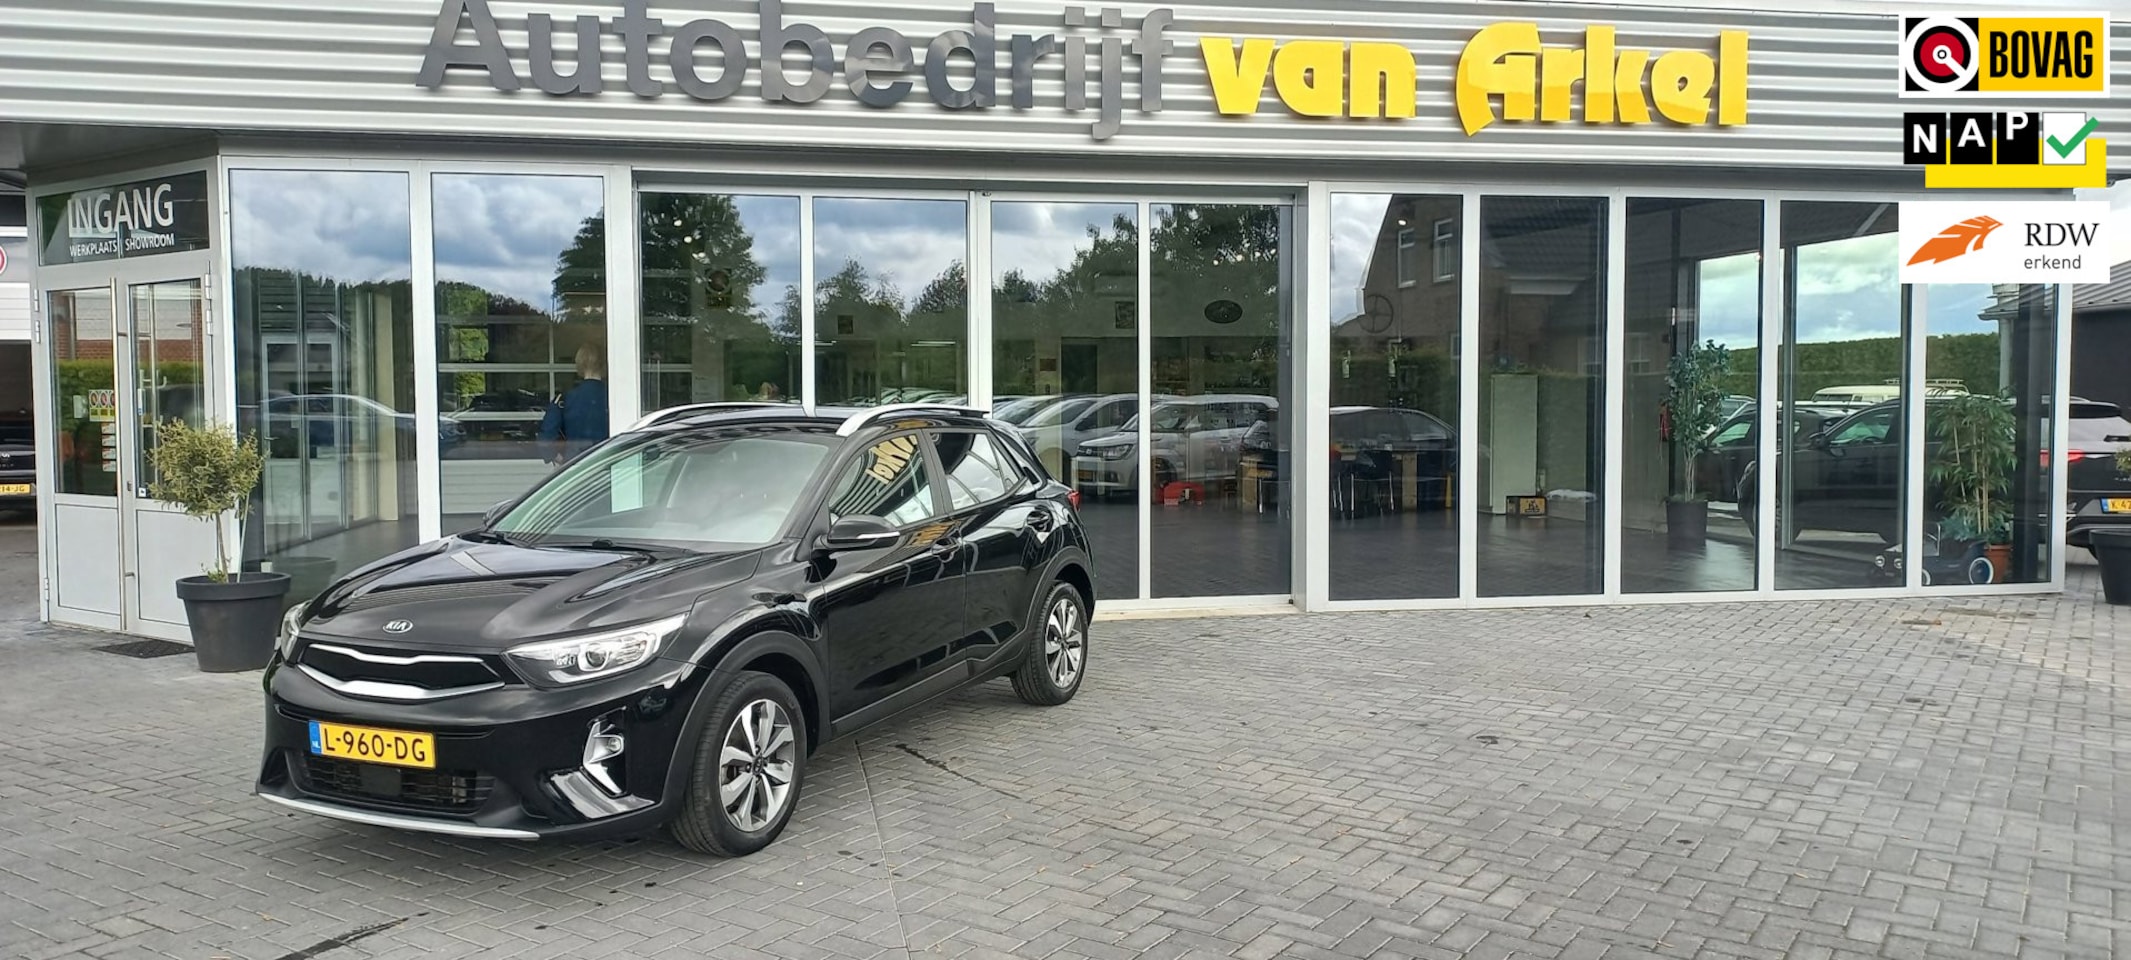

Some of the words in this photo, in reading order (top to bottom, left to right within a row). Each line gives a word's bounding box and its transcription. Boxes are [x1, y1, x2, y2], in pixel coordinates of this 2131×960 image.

[415, 0, 1176, 140] Autobedrijf
[1199, 37, 1417, 119] van
[1455, 21, 1749, 137] Arkel
[67, 183, 174, 235] INGANG
[69, 239, 118, 257] WERKPLAATS
[124, 233, 175, 252] SHOWROOM
[385, 620, 409, 631] KIA
[324, 727, 426, 762] L-960-DG
